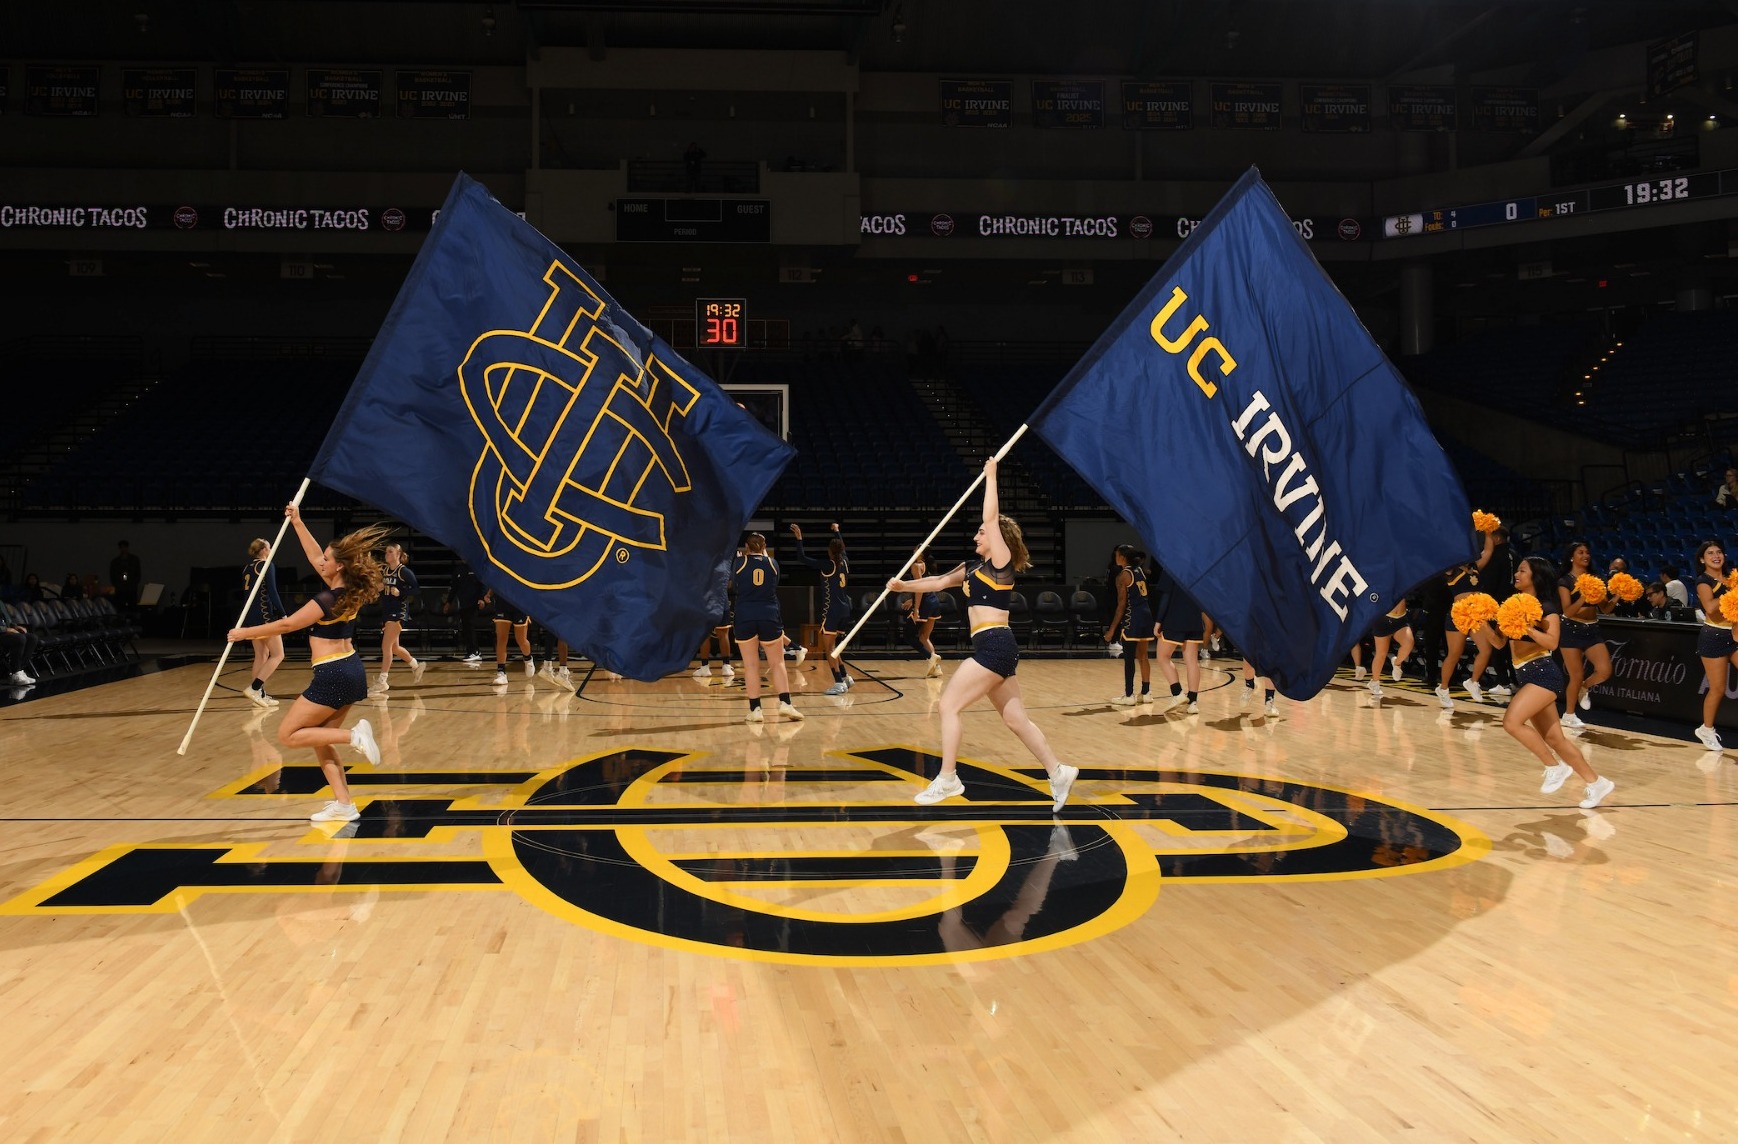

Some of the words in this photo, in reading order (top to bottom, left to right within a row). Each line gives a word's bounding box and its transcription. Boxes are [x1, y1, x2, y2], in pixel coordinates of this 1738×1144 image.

[51, 87, 95, 97] IRVINE
[126, 89, 144, 99] UC
[148, 88, 194, 99] IRVINE
[218, 89, 236, 100] UC
[240, 89, 285, 100] IRVINE
[310, 88, 327, 99] UC
[332, 89, 379, 100] IRVINE
[399, 90, 418, 101] UC
[421, 91, 468, 102] IRVINE
[944, 99, 961, 109] UC
[965, 99, 1010, 110] IRVINE
[1036, 99, 1053, 110] UC
[1057, 100, 1101, 110] IRVINE
[1126, 101, 1143, 112] UC
[1147, 101, 1189, 111] IRVINE
[1213, 102, 1231, 112] UC
[1234, 102, 1279, 113] IRVINE
[1305, 104, 1321, 114] UC
[1325, 103, 1367, 114] IRVINE
[1411, 104, 1454, 115] IRVINE
[1065, 113, 1093, 122] 2025
[1495, 106, 1537, 117] IRVINE
[1624, 177, 1690, 204] 19:32
[623, 203, 648, 213] HOME
[737, 205, 764, 214] GUEST
[1505, 202, 1518, 220] 0
[1555, 201, 1577, 215] 1ST
[0, 205, 86, 227] CHRONIC
[87, 206, 147, 228] TACOS
[224, 207, 308, 229] CHRONIC
[309, 208, 369, 230] TACOS
[860, 214, 906, 235] ACOS
[979, 215, 1059, 236] CHRONIC
[1060, 216, 1118, 238] TACOS
[673, 228, 697, 236] PERIOD
[76, 262, 96, 274] 109
[289, 264, 305, 277] 110
[788, 269, 802, 280] 112
[1071, 271, 1085, 283] 113
[706, 303, 741, 318] 19:32
[706, 318, 737, 344] 30
[1150, 285, 1238, 399] UC
[1231, 390, 1370, 623] IRVINE
[752, 568, 765, 586] 0
[839, 572, 846, 588] 3
[1605, 639, 1687, 685] Fornaio
[1617, 687, 1661, 703] ITALIANA
